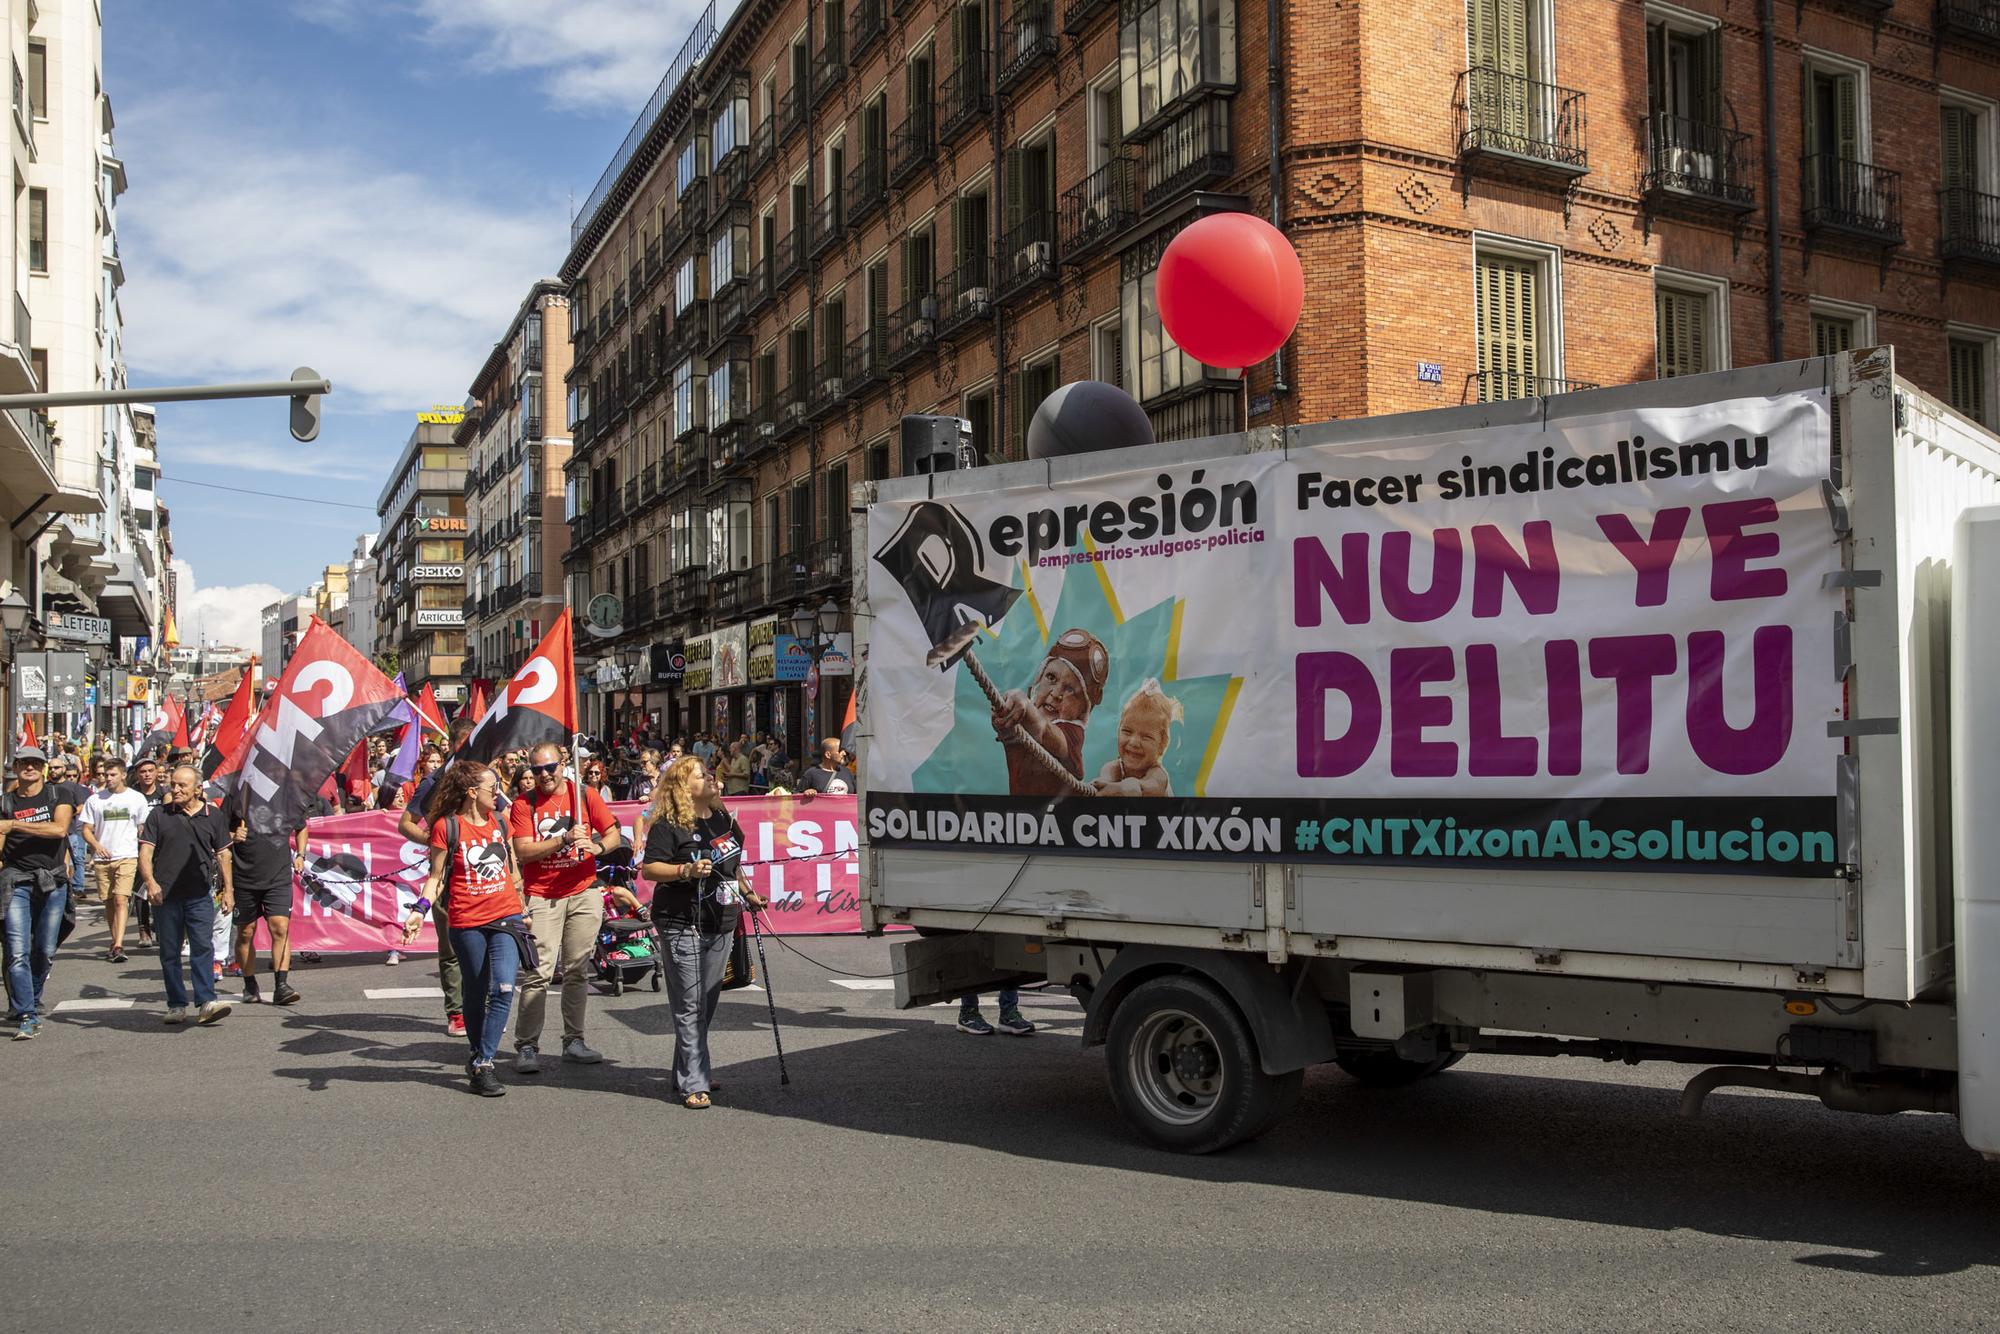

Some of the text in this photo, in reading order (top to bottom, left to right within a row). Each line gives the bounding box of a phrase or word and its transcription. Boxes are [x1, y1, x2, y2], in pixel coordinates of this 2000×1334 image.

[1297, 435, 1769, 511] Facer sindicalismu
[414, 566, 463, 578] SEIKO
[1293, 497, 1789, 628] NUN YE
[49, 615, 109, 633] LETERIA
[1295, 624, 1794, 778] DELITU
[868, 804, 1835, 863] SOLIDARIDÁ CNT XIXÓN #CNTXixonAbsolucion
[775, 891, 806, 913] de
